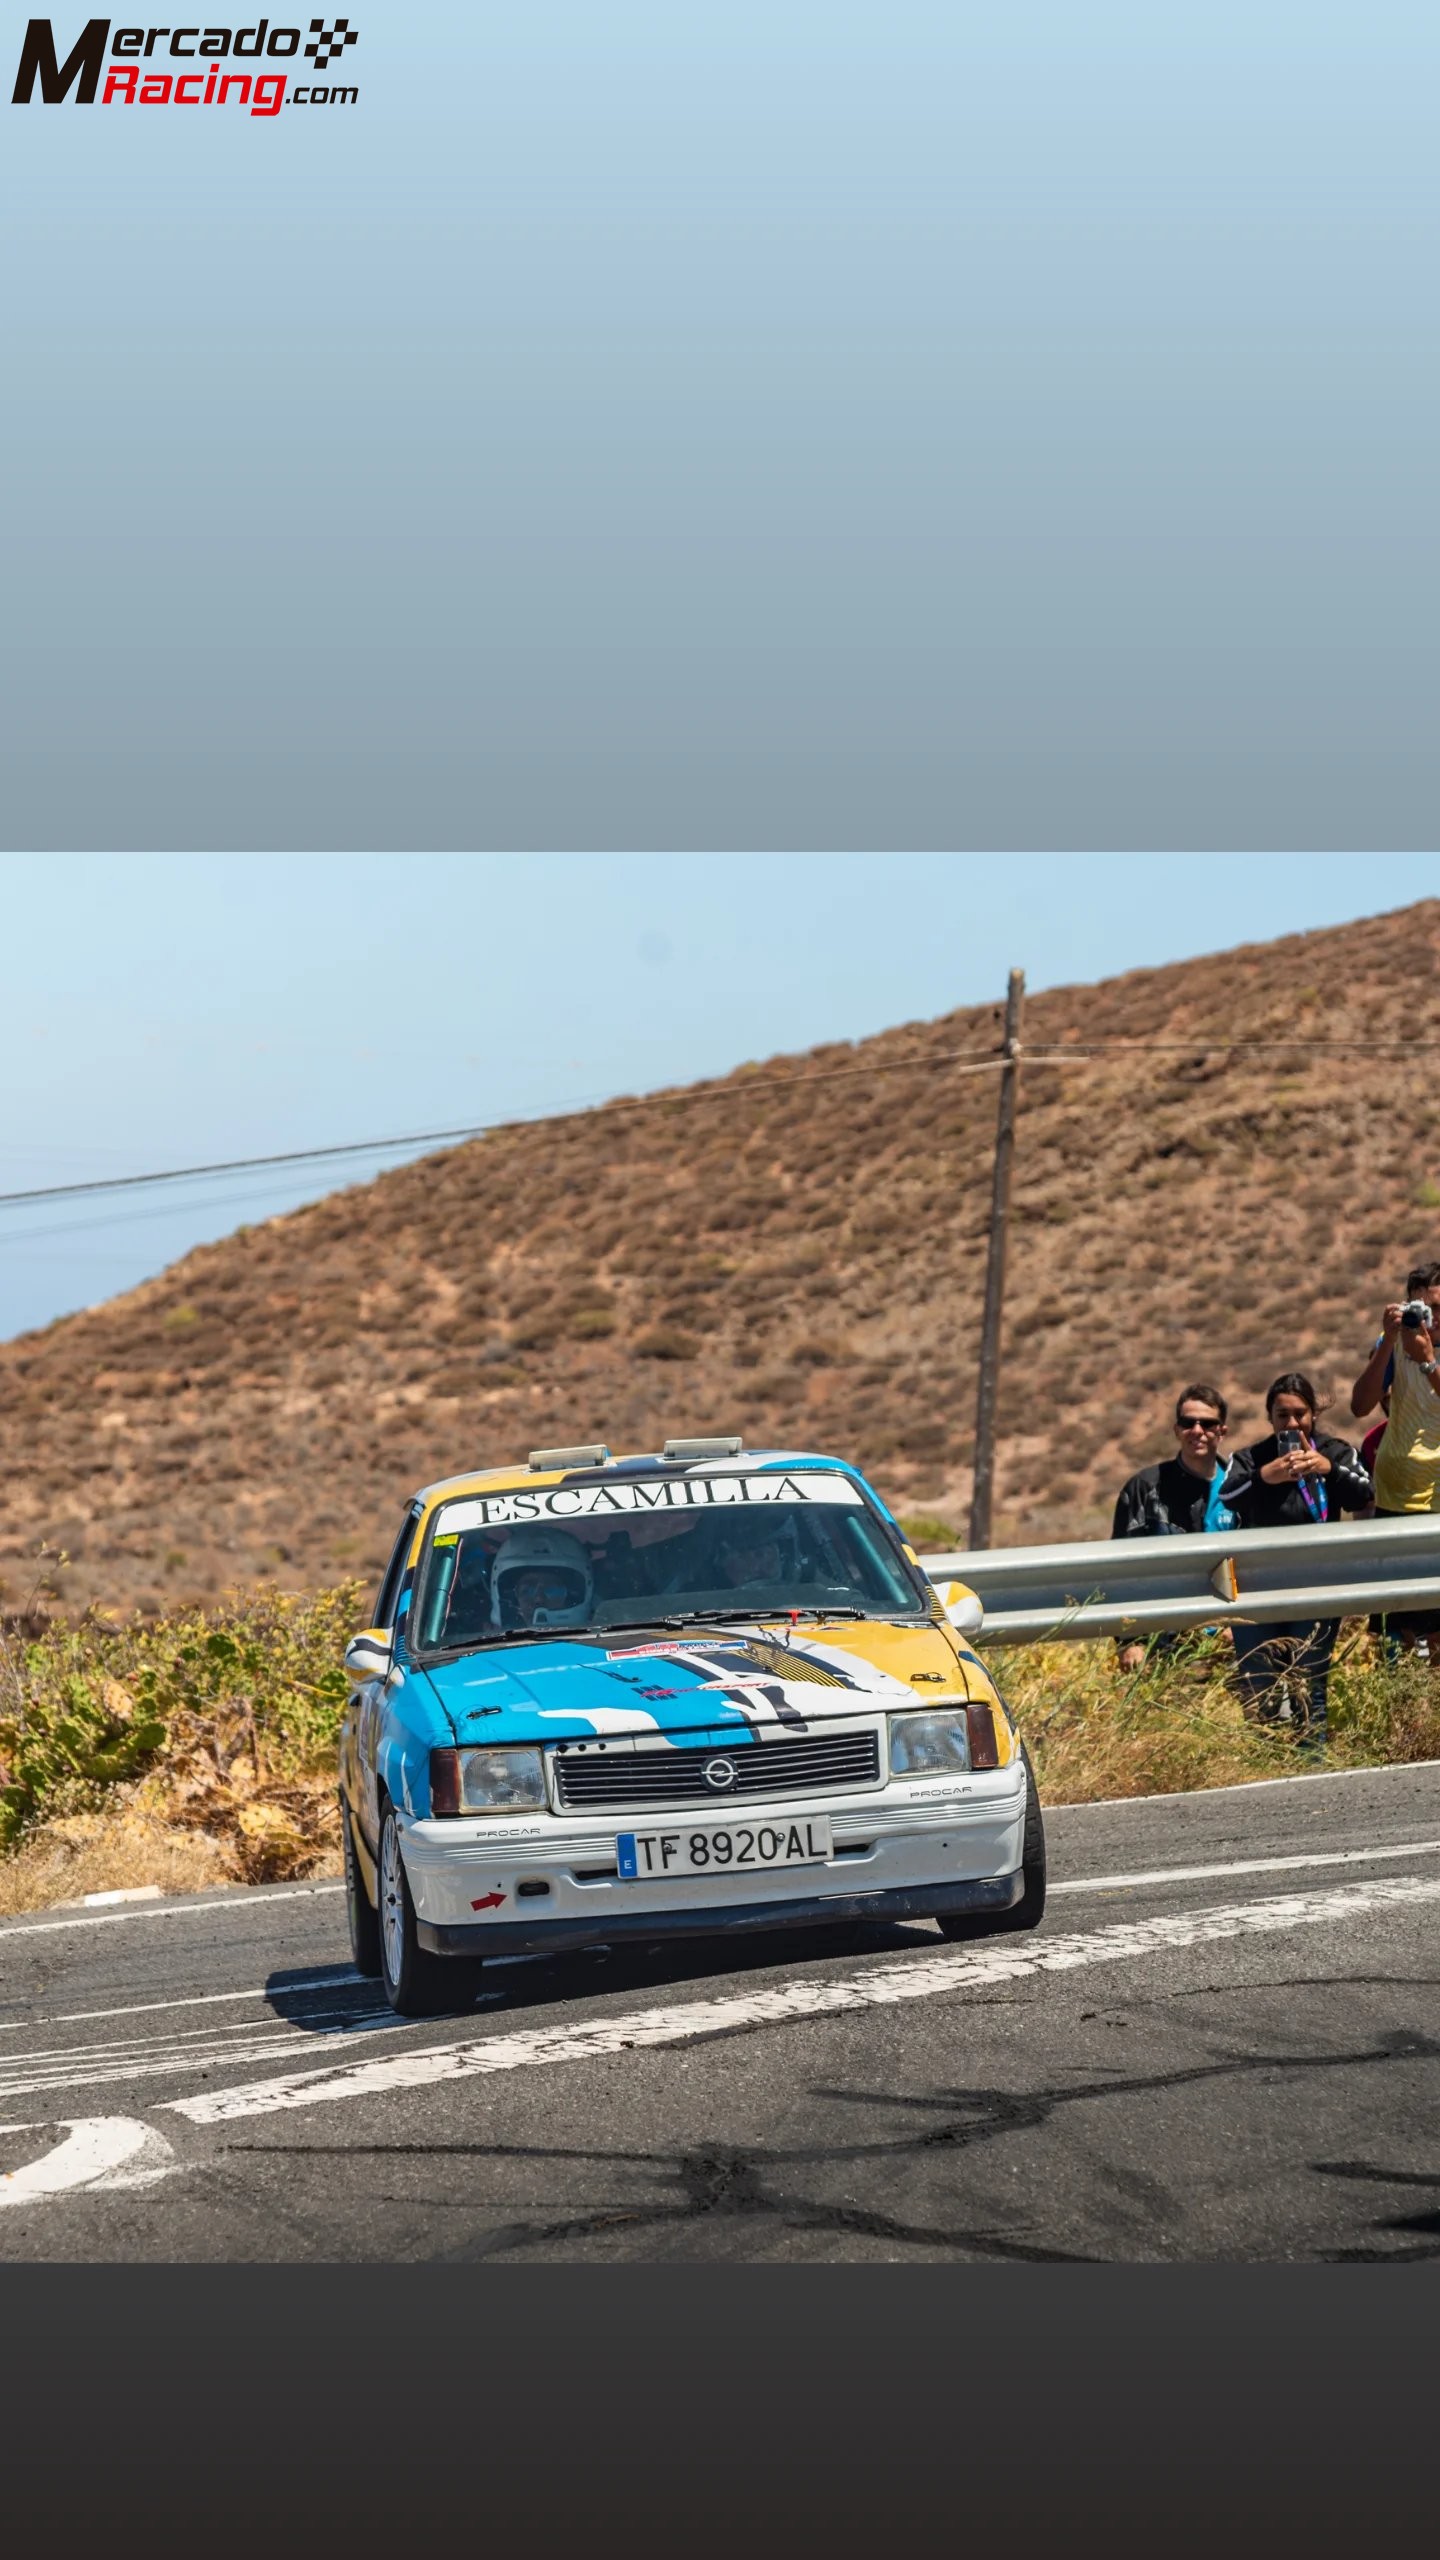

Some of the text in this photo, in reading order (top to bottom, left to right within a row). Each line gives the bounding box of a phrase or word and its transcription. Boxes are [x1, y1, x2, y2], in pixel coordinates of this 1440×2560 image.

[477, 1476, 812, 1525] ESCAMILLA
[909, 1786, 972, 1798] PROCAR
[476, 1828, 541, 1838] PROCAR
[637, 1824, 827, 1870] TF 8920 AL
